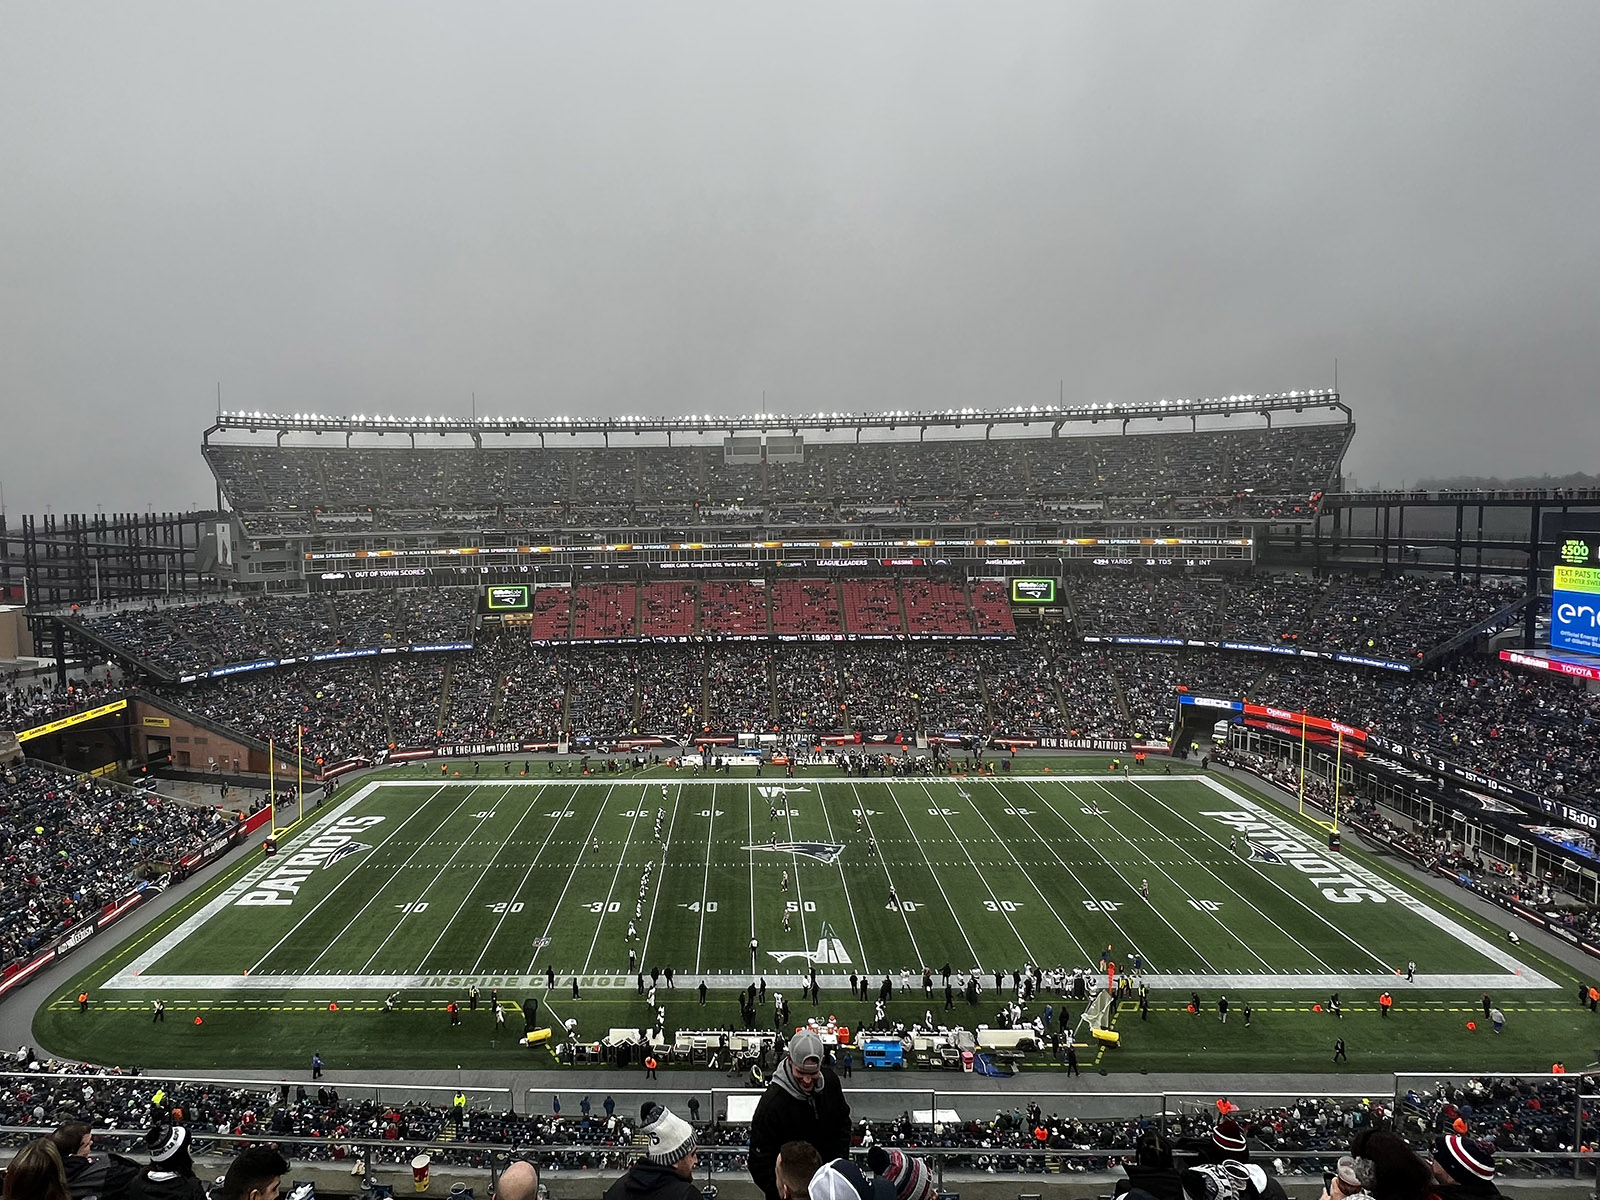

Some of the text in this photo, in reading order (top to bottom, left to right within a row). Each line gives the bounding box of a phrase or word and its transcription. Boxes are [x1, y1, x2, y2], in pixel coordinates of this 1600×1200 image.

[1561, 545, 1589, 556] $500
[1558, 569, 1572, 577] TEXT
[1575, 570, 1591, 578] PATS
[1560, 630, 1598, 641] Official Energy
[1561, 664, 1592, 677] TOYOTA
[1194, 697, 1231, 709] GEICO
[1266, 708, 1291, 719] Optum
[1331, 721, 1354, 735] Optum
[1041, 738, 1127, 750] NEW ENGLAND PATRIOTS
[1392, 743, 1403, 754] 28
[437, 746, 453, 756] NEW
[455, 744, 485, 755] ENGLAND
[1438, 761, 1445, 771] 3
[1465, 771, 1477, 781] 1ST
[1487, 779, 1497, 789] 10
[1562, 806, 1597, 828] 15:00
[234, 816, 386, 906] PATRIOTS
[1199, 811, 1387, 903] PATRIOTS
[1350, 866, 1424, 911] JUSTICE
[401, 902, 429, 913] 10
[493, 902, 525, 913] 20
[590, 902, 621, 912] 30
[688, 902, 718, 912] 40
[786, 902, 816, 912] 50
[885, 901, 917, 912] 40
[983, 900, 1016, 911] 30
[1082, 900, 1118, 911] 20
[1187, 900, 1220, 910] 10
[419, 977, 627, 987] INSPIRE CHANGE
